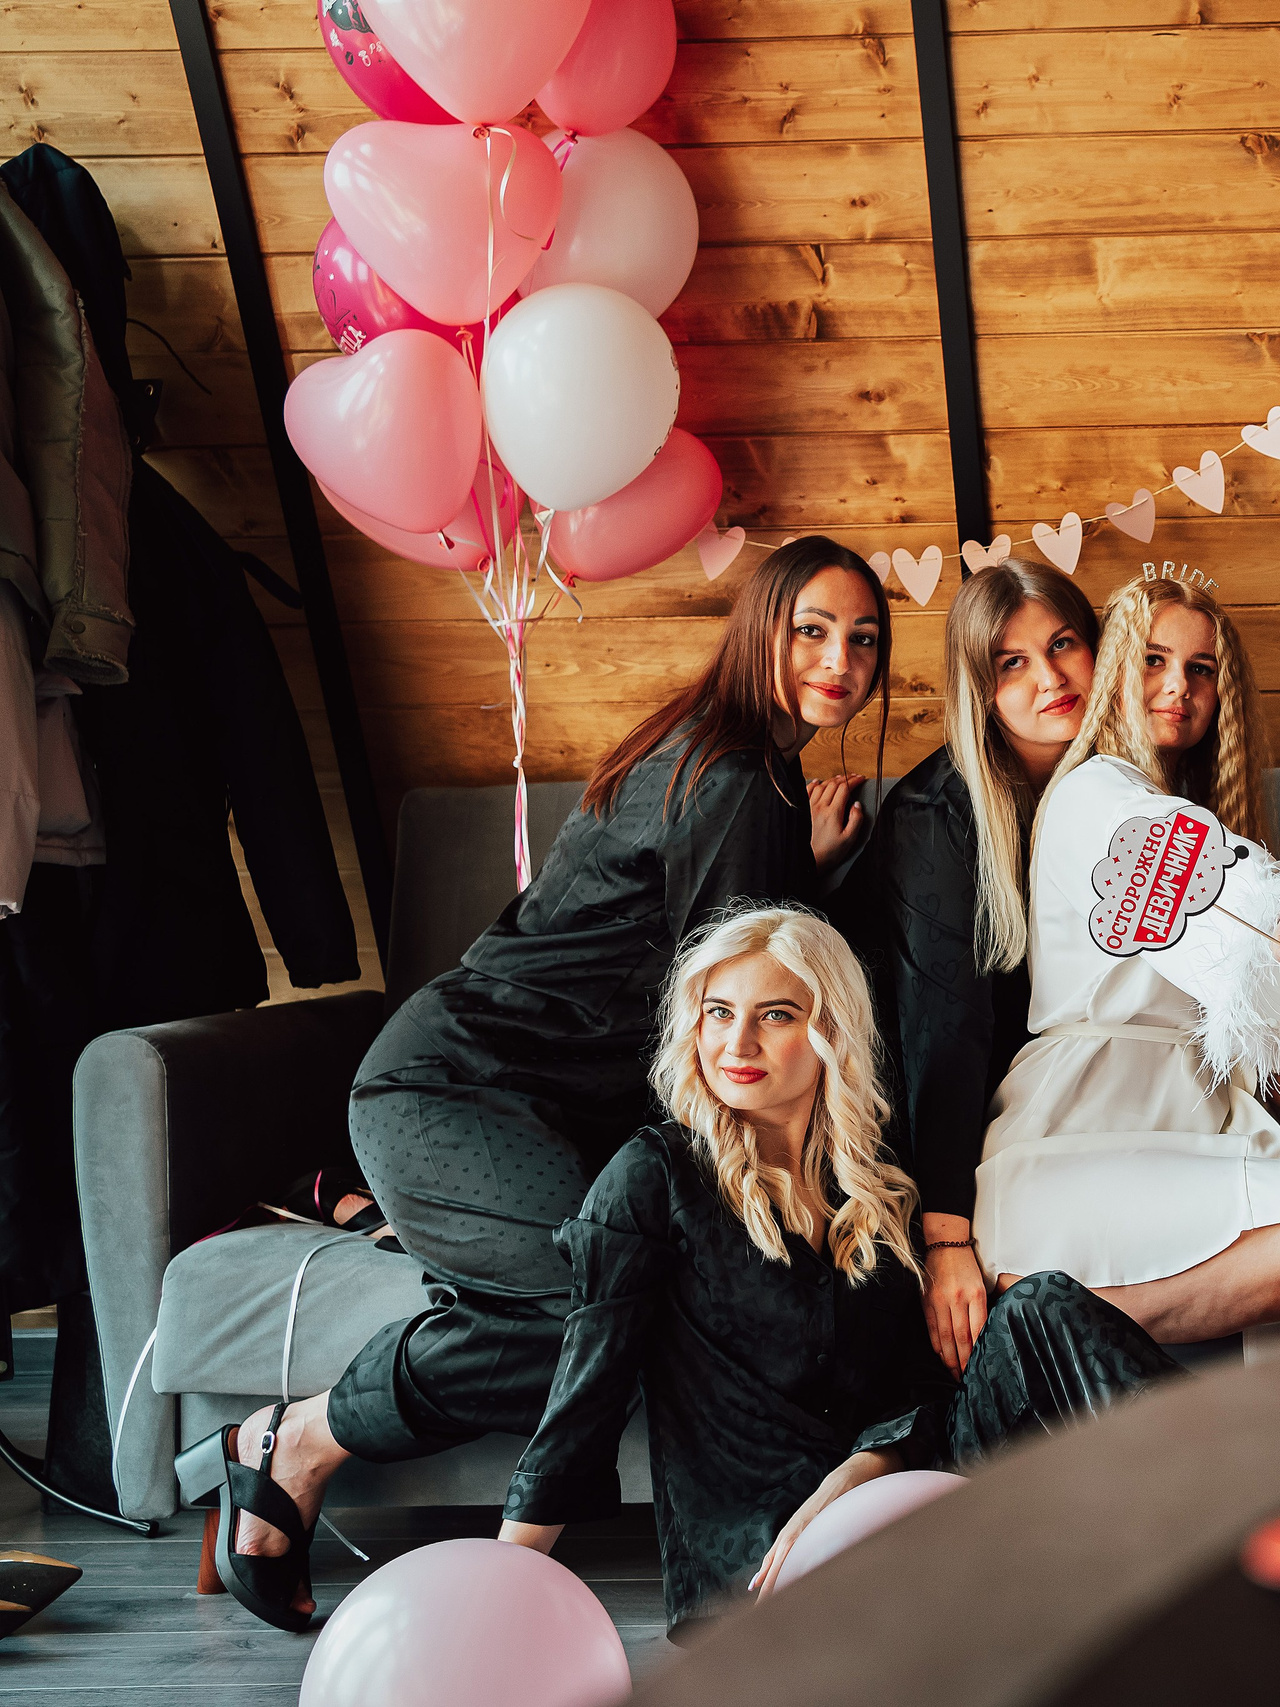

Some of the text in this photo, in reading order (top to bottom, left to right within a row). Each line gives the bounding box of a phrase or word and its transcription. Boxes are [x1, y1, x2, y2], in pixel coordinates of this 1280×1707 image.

[1142, 560, 1220, 595] BRIDE
[1106, 820, 1172, 950] ОСТОРОЖНО,
[1141, 826, 1199, 938] ДЕВИЧНИК
